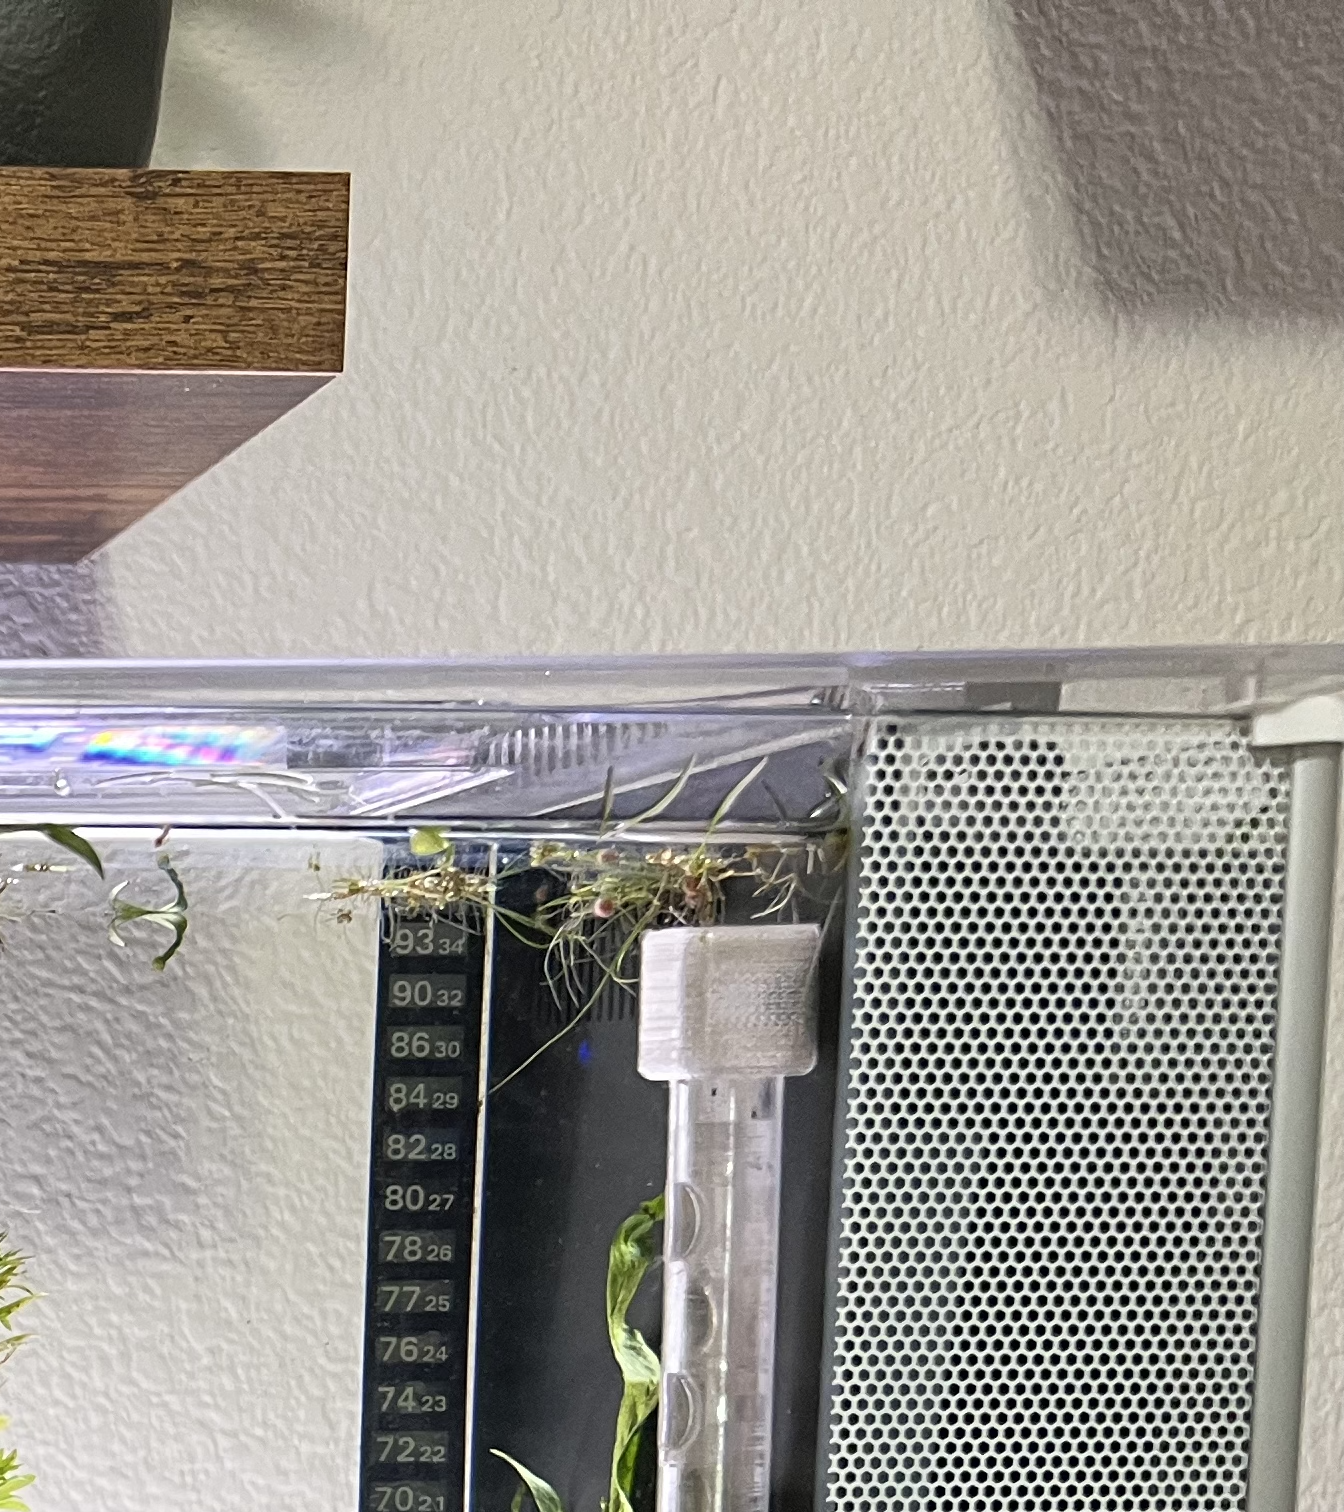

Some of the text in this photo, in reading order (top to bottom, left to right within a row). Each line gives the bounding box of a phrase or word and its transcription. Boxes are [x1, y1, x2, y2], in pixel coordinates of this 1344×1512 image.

[395, 929, 434, 954] 93
[393, 980, 462, 1006] 90 32
[391, 1032, 460, 1058] 86 30
[389, 1084, 458, 1109] 84 29
[387, 1135, 456, 1160] 82 28
[385, 1186, 454, 1211] 80 27
[383, 1236, 451, 1261] 78 26
[381, 1286, 450, 1311] 77 25
[379, 1337, 448, 1361] 76 24
[377, 1387, 446, 1412] 74 23
[376, 1437, 445, 1463] 72 22
[374, 1487, 444, 1511] 70 21
